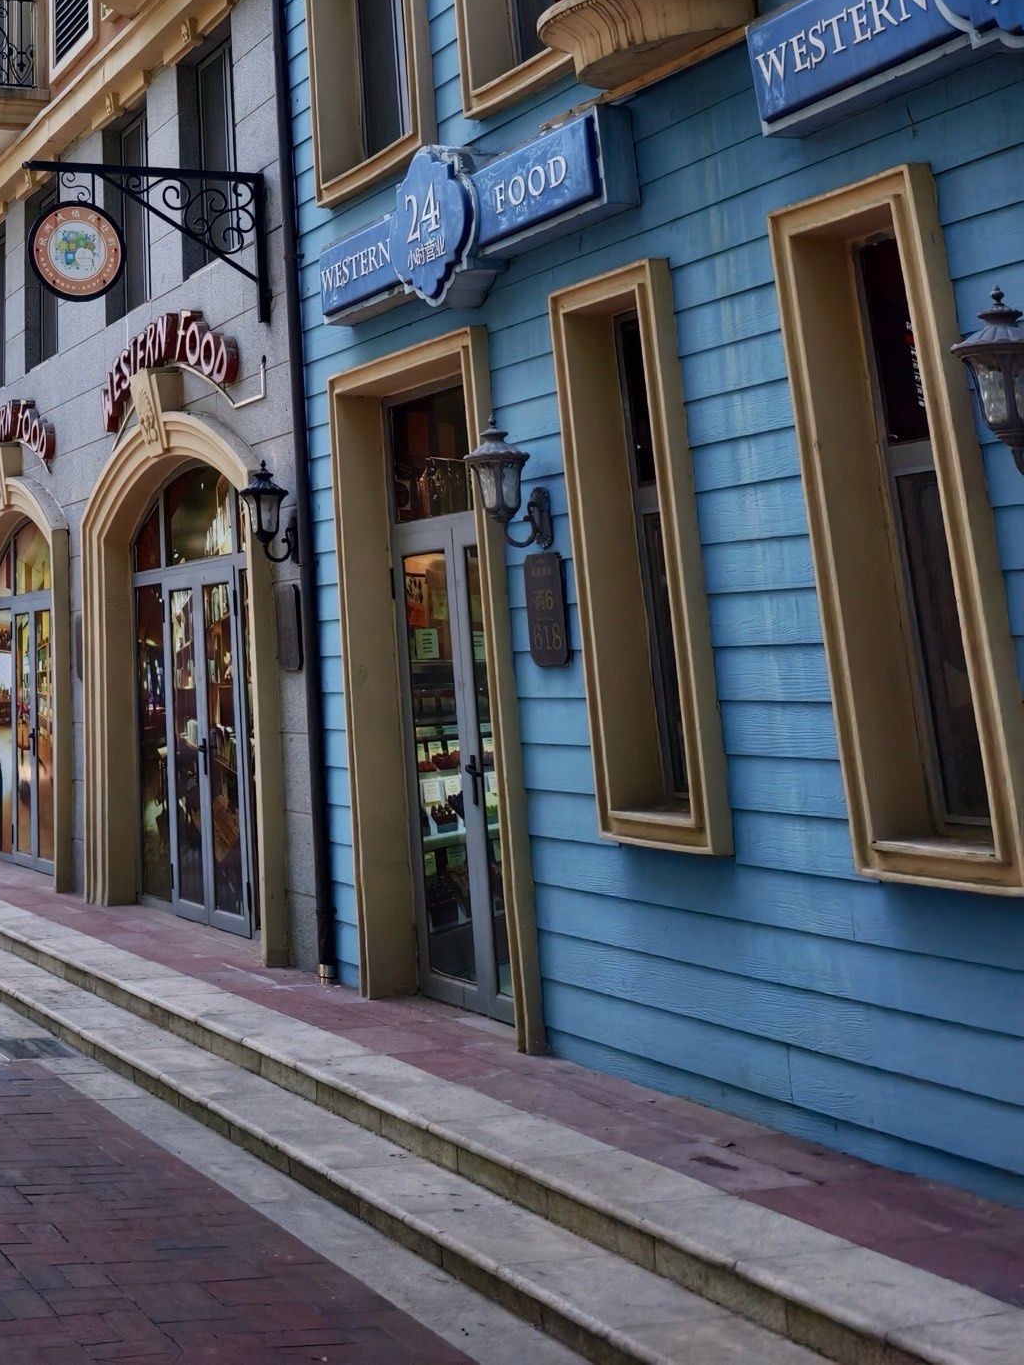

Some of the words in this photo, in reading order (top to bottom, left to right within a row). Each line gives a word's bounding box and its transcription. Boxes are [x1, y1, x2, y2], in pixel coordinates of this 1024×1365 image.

[320, 238, 391, 292] WESTERN
[494, 155, 567, 215] FOOD
[405, 182, 441, 244] 24
[407, 235, 446, 271] 小时营业
[101, 314, 169, 433] WESTERN
[175, 309, 229, 385] FOOD
[16, 399, 48, 459] FOOD
[534, 624, 562, 650] 618
